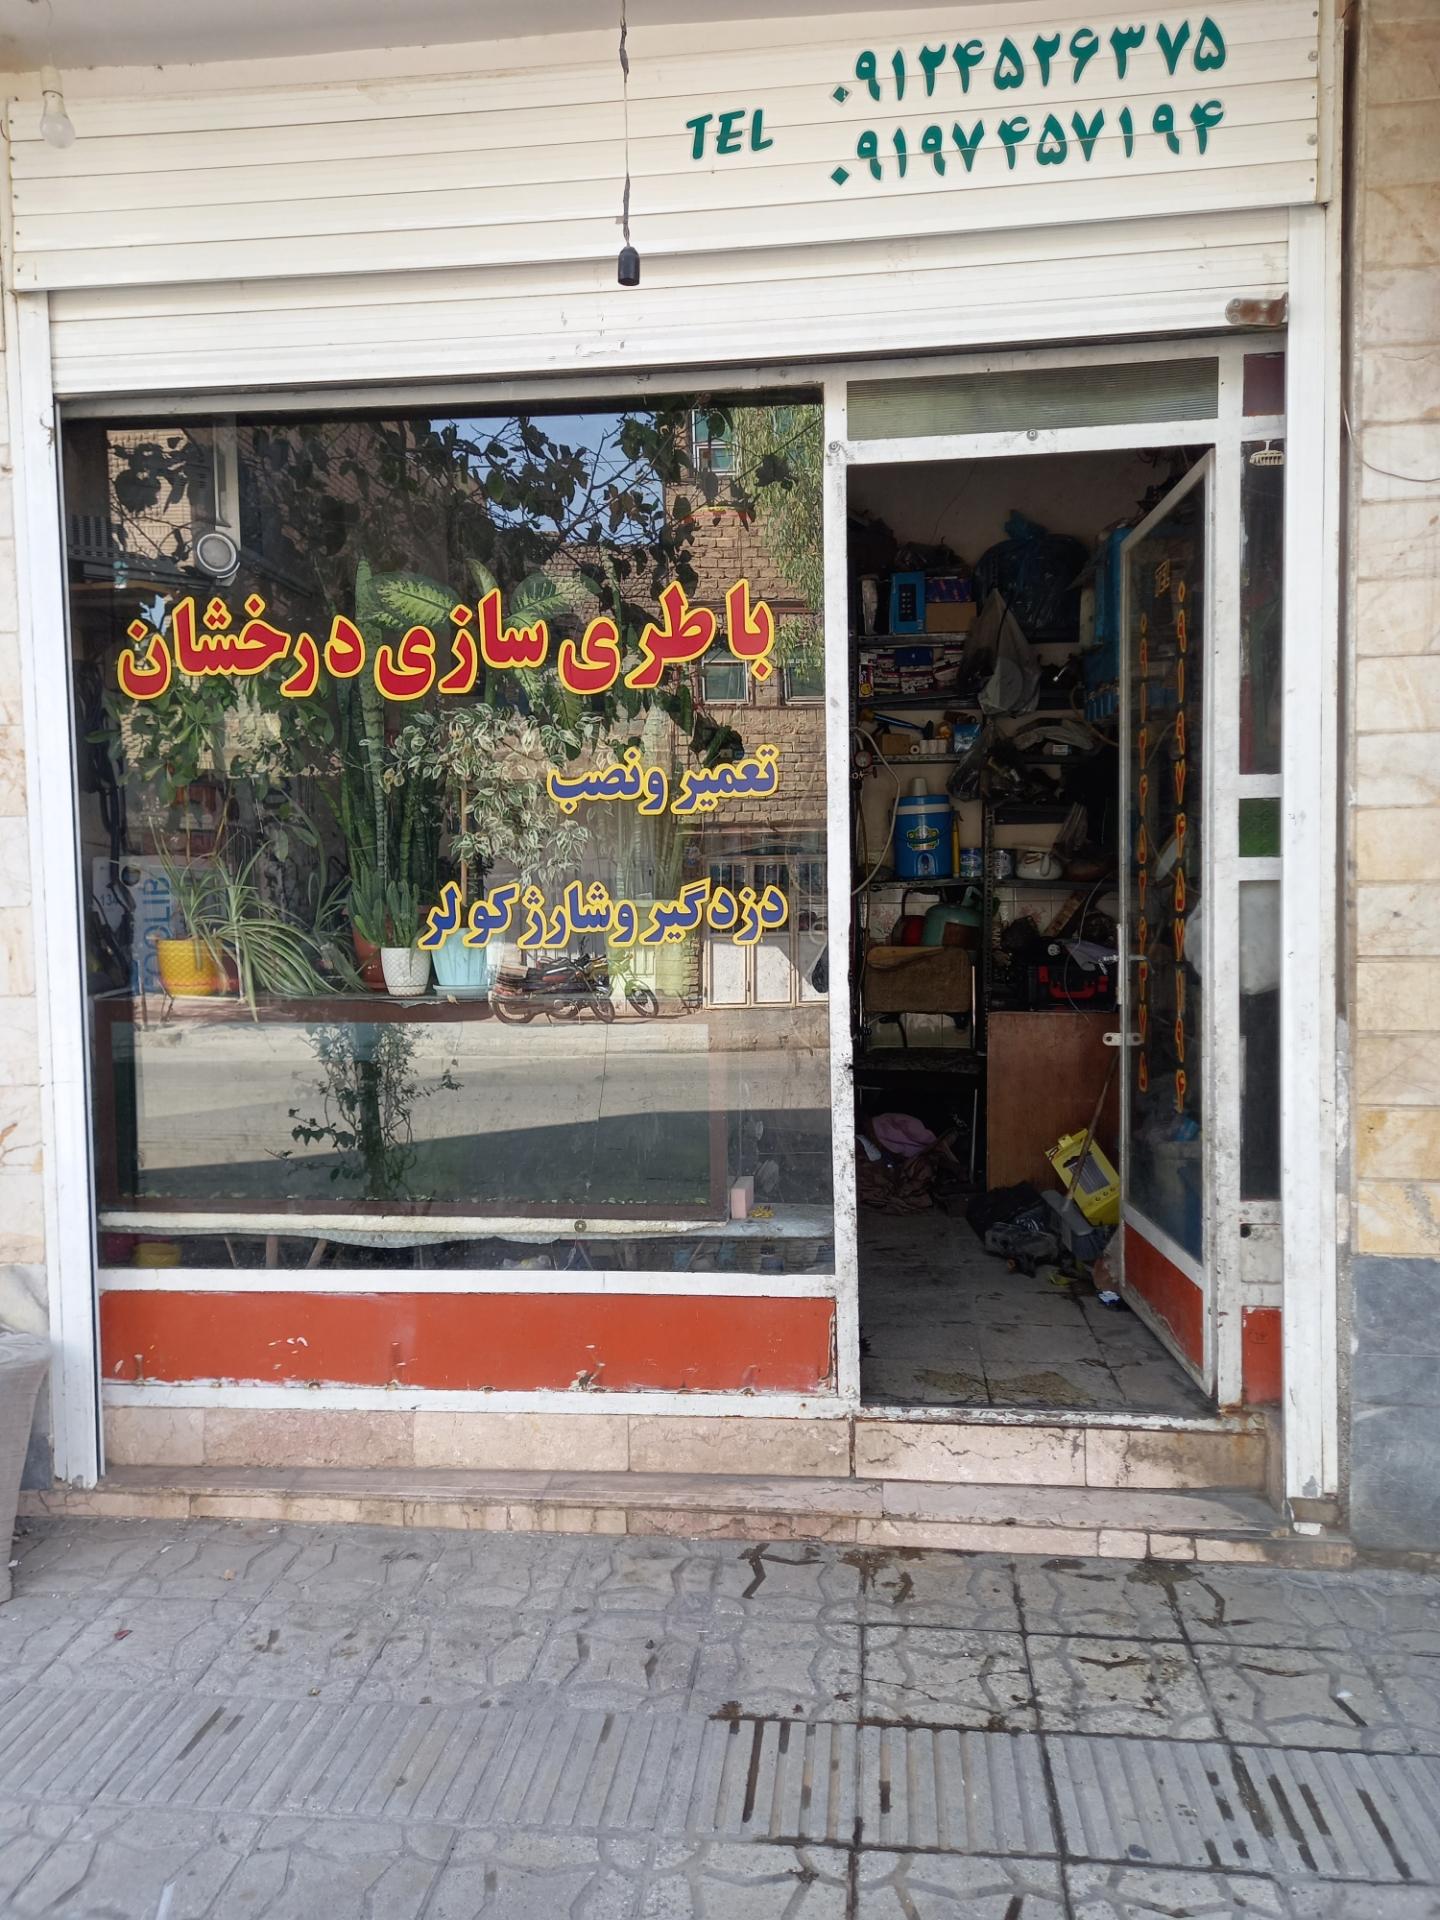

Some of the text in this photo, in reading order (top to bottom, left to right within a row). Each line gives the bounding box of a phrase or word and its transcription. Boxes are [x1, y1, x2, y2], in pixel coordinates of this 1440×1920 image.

[831, 16, 1227, 103] ۰۹۱۲۴۵۲۶۳۷۵
[686, 108, 774, 161] TEL
[830, 99, 1225, 187] ۰۹۱۹۷۴۵۷۱۹۴
[117, 593, 366, 700] درخشان
[374, 587, 549, 701] سازی
[670, 744, 780, 816] تعمیر
[417, 880, 520, 950] کولر
[639, 877, 789, 946] دزدگیر
